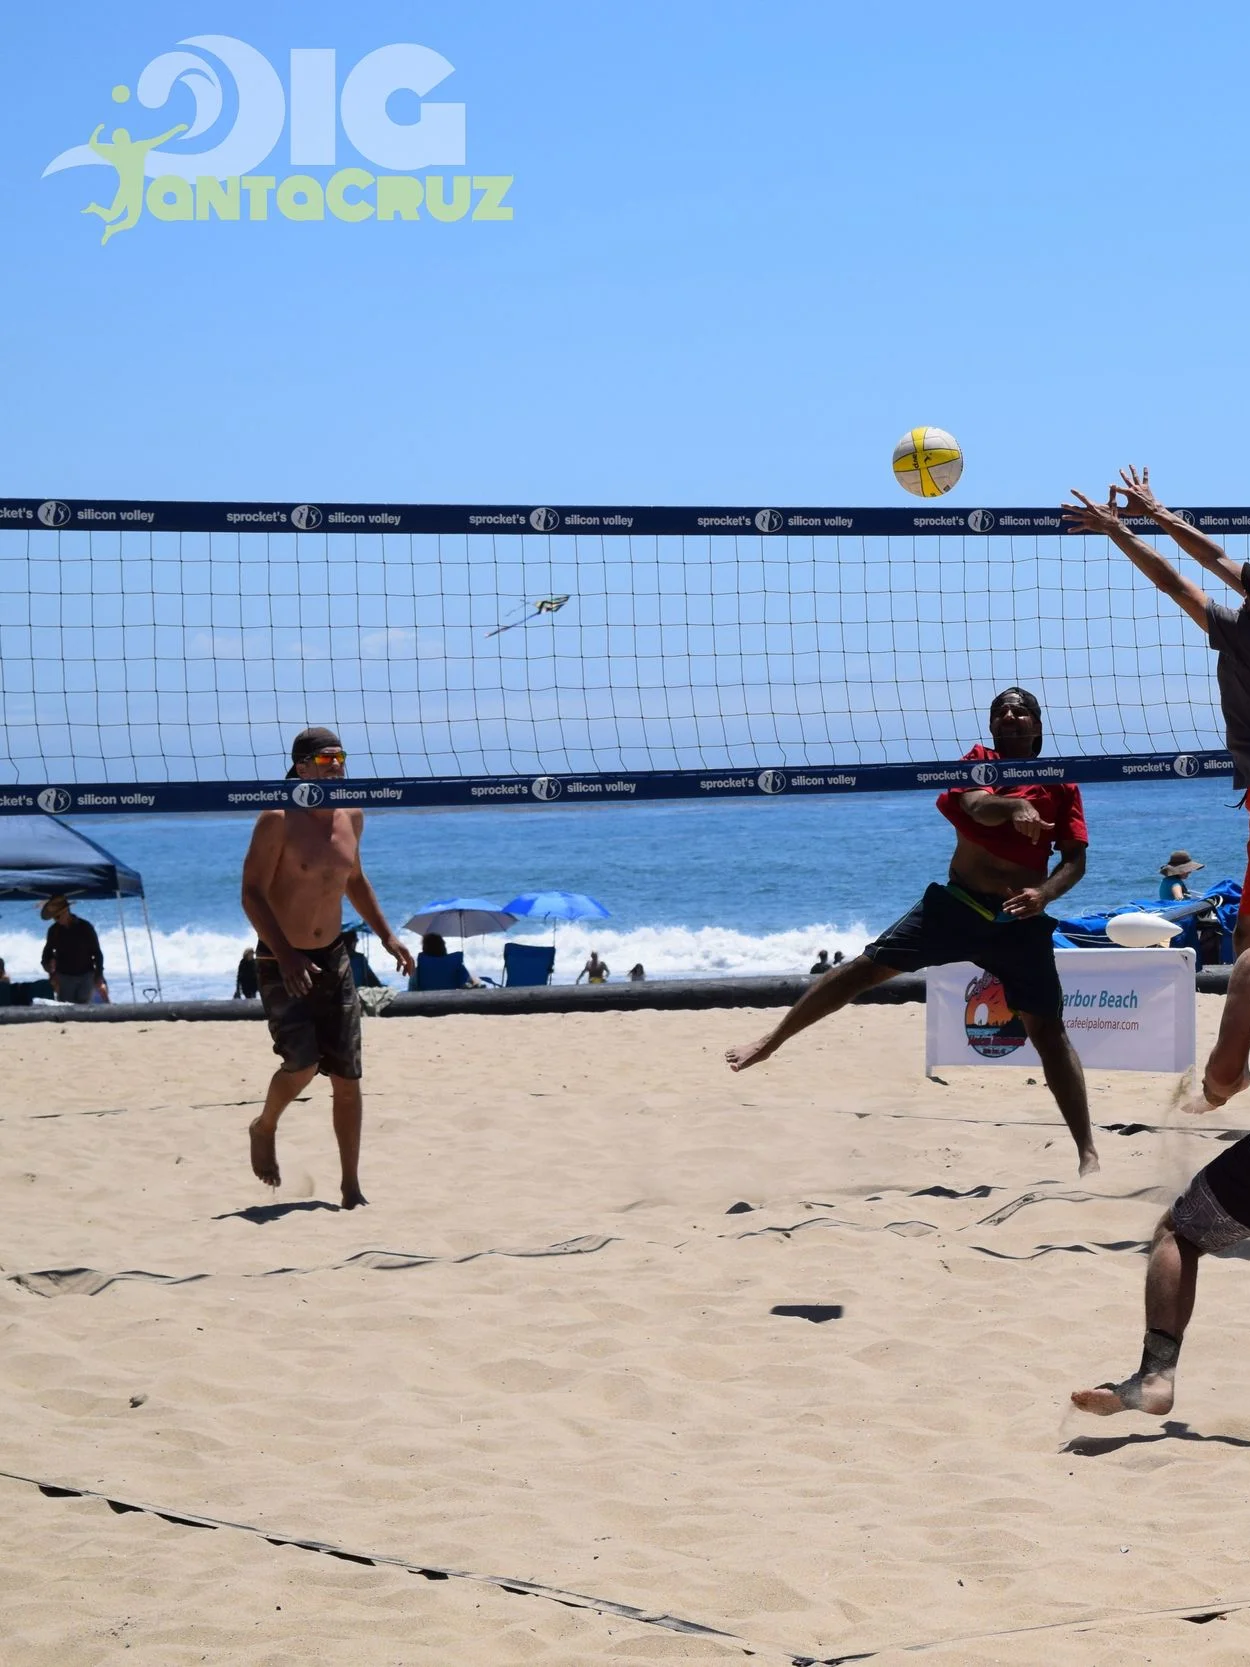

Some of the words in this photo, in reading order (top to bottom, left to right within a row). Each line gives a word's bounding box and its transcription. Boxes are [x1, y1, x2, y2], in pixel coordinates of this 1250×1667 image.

[77, 508, 116, 520] silicon
[119, 509, 155, 523] volley
[226, 511, 287, 524] sprocket's
[328, 512, 365, 523] silicon
[368, 513, 401, 526] volley
[469, 513, 526, 526] sprocket's
[564, 514, 600, 525] silicon
[602, 514, 634, 528] volley
[697, 515, 751, 528] sprocket's
[788, 515, 821, 526] silicon
[823, 516, 853, 528] volley
[913, 516, 965, 528] sprocket's
[999, 515, 1031, 526] silicon
[1033, 516, 1061, 528] volley
[1199, 515, 1230, 526] silicon
[1122, 762, 1171, 775] sprocket's
[1203, 759, 1234, 770] silicon
[700, 777, 754, 790] sprocket's
[791, 775, 825, 786] silicon
[827, 775, 856, 786] volley
[917, 770, 968, 783] sprocket's
[1002, 768, 1034, 778] silicon
[1036, 767, 1065, 778] volley
[228, 790, 288, 803] sprocket's
[329, 788, 367, 800] silicon
[370, 788, 403, 800] volley
[471, 784, 528, 797] sprocket's
[567, 782, 602, 793] silicon
[605, 781, 636, 793] volley
[77, 794, 117, 805] silicon
[120, 793, 155, 806] volley
[1062, 989, 1097, 1008] arbor
[1098, 989, 1138, 1009] Beach
